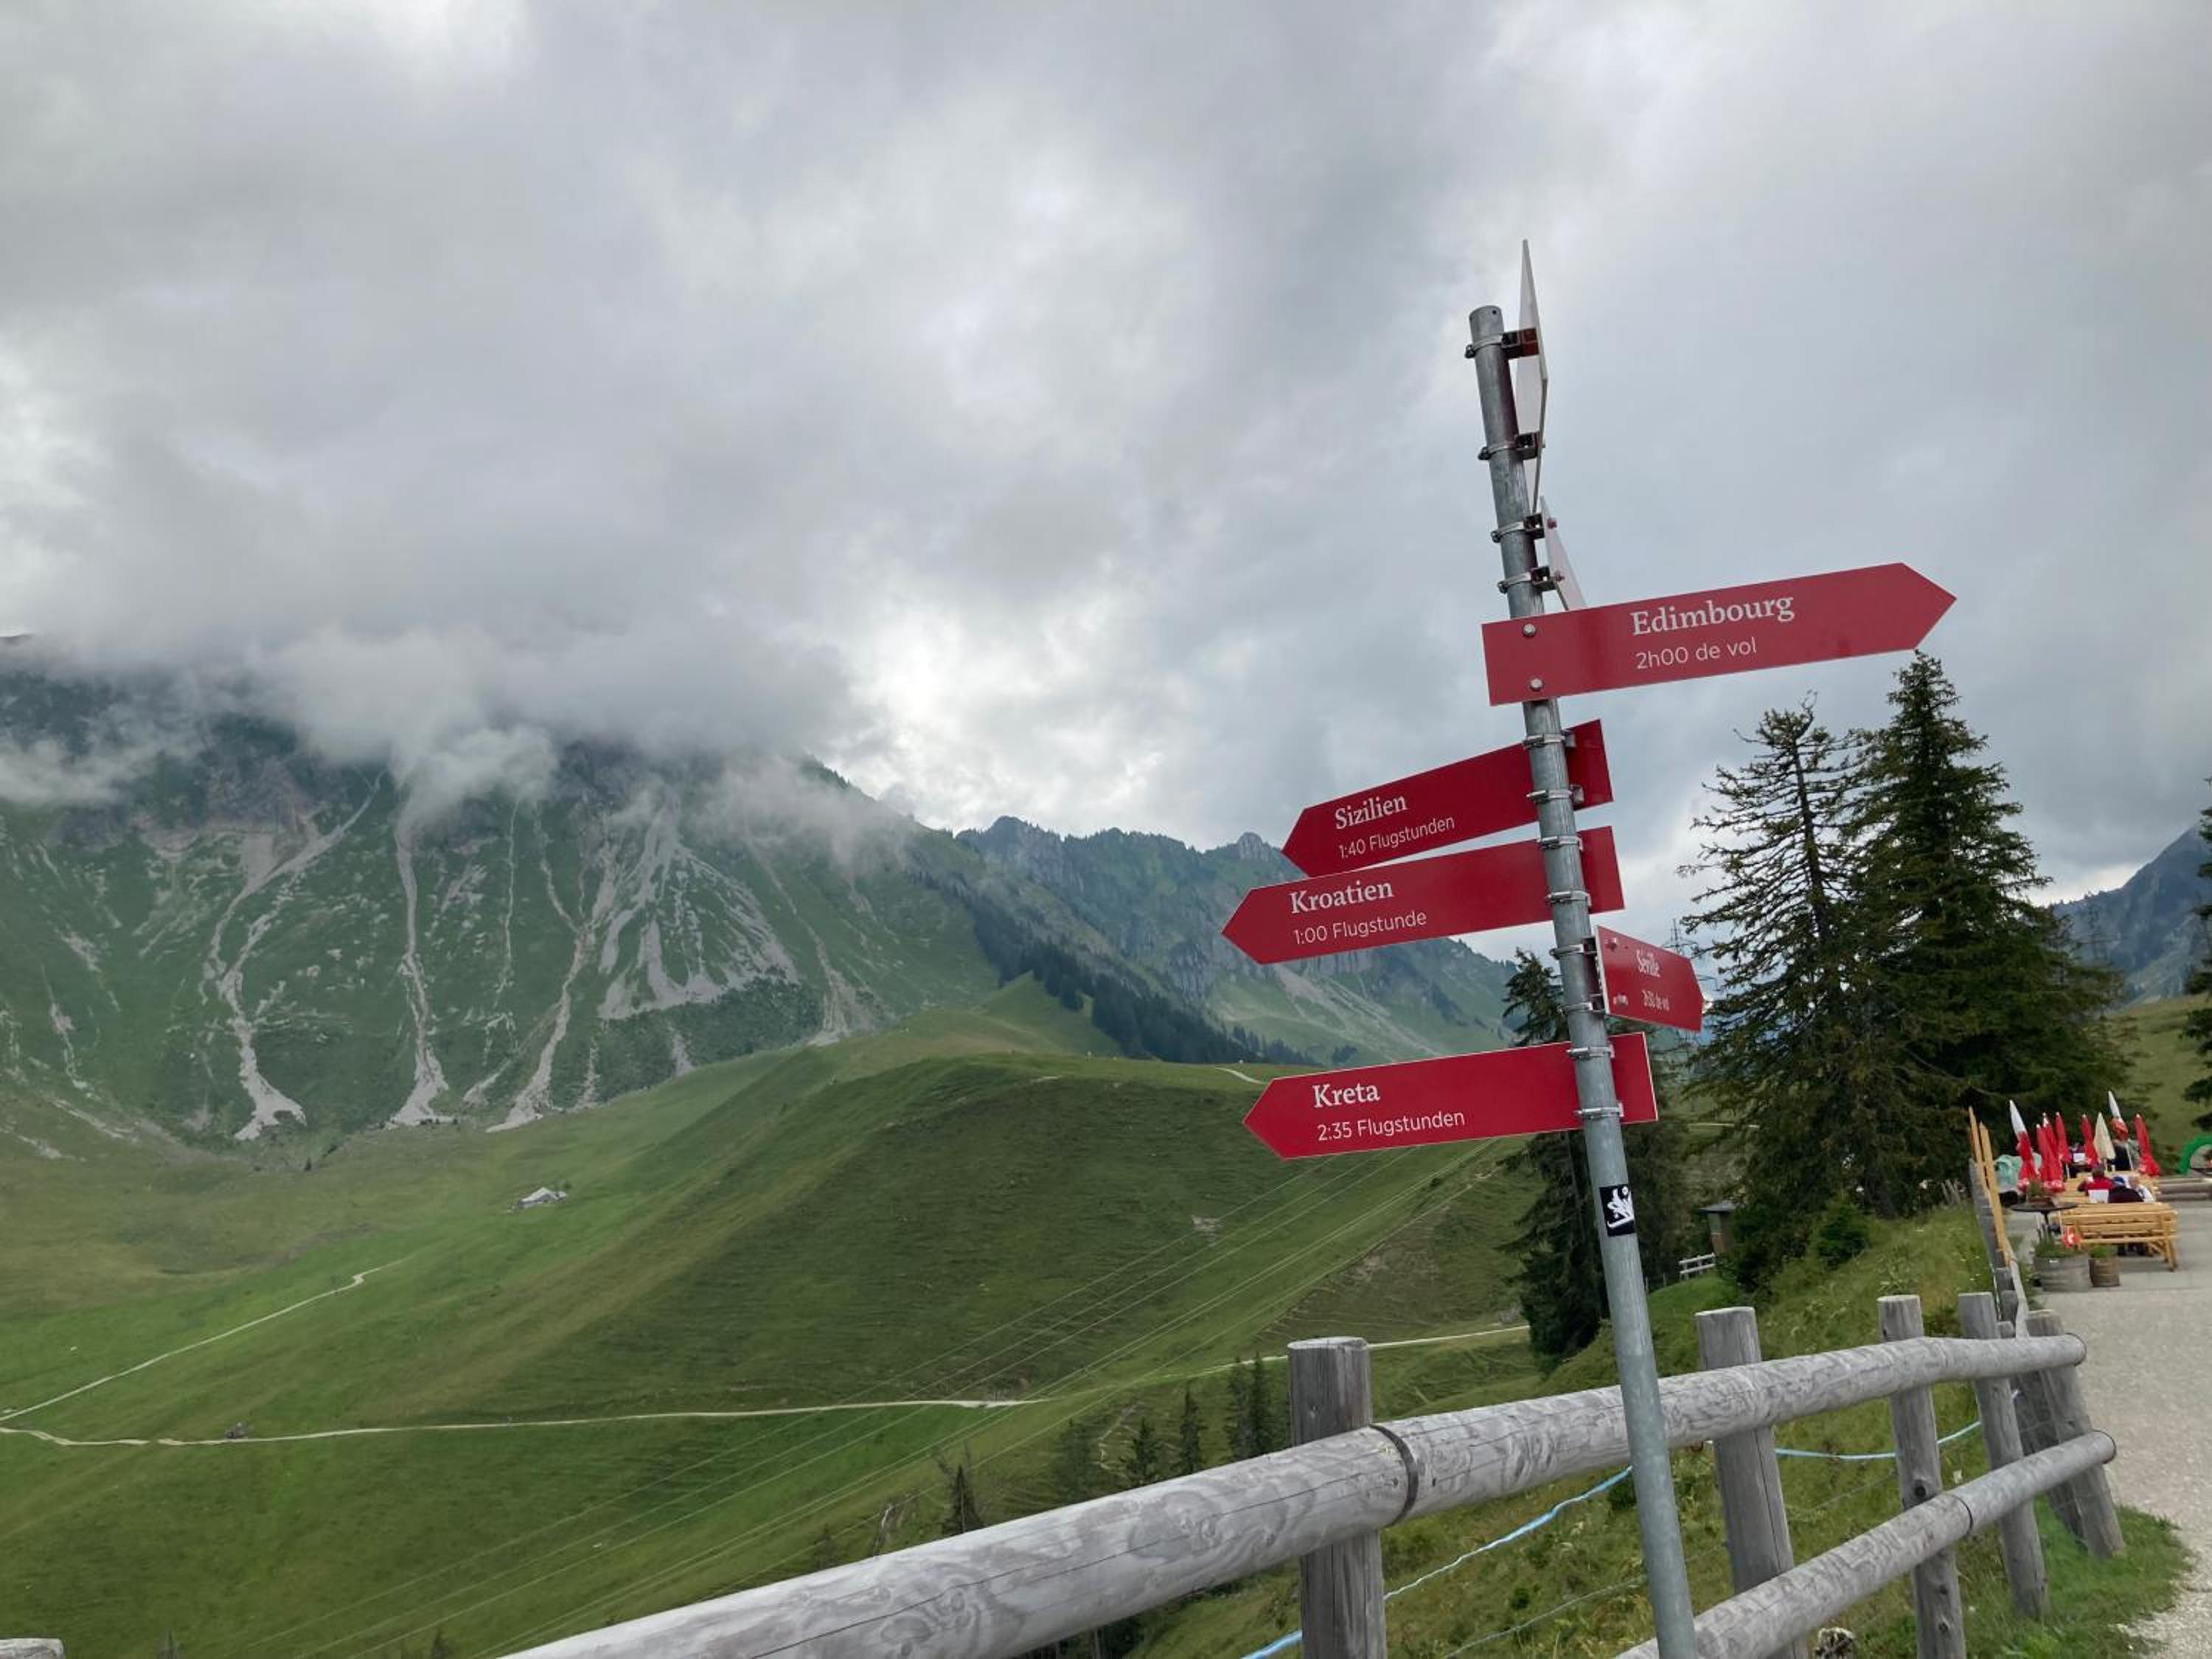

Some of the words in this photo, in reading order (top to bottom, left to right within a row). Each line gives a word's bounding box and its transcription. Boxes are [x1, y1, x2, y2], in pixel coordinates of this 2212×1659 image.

[1630, 596, 1795, 635] Edimbourg
[1635, 646, 1688, 669] 2h00
[1695, 643, 1720, 661] de
[1727, 636, 1757, 656] vol
[1335, 796, 1408, 830] Sizilien
[1338, 839, 1366, 859] 1:40
[1369, 816, 1455, 850] Flugstunden
[1290, 880, 1394, 914] Kroatien
[1294, 925, 1328, 945] 1:00
[1332, 911, 1427, 939] Flugstunde
[1312, 1082, 1381, 1108] Kreta
[1317, 1121, 1353, 1141] 2:35
[1357, 1110, 1465, 1137] Flugstunden
